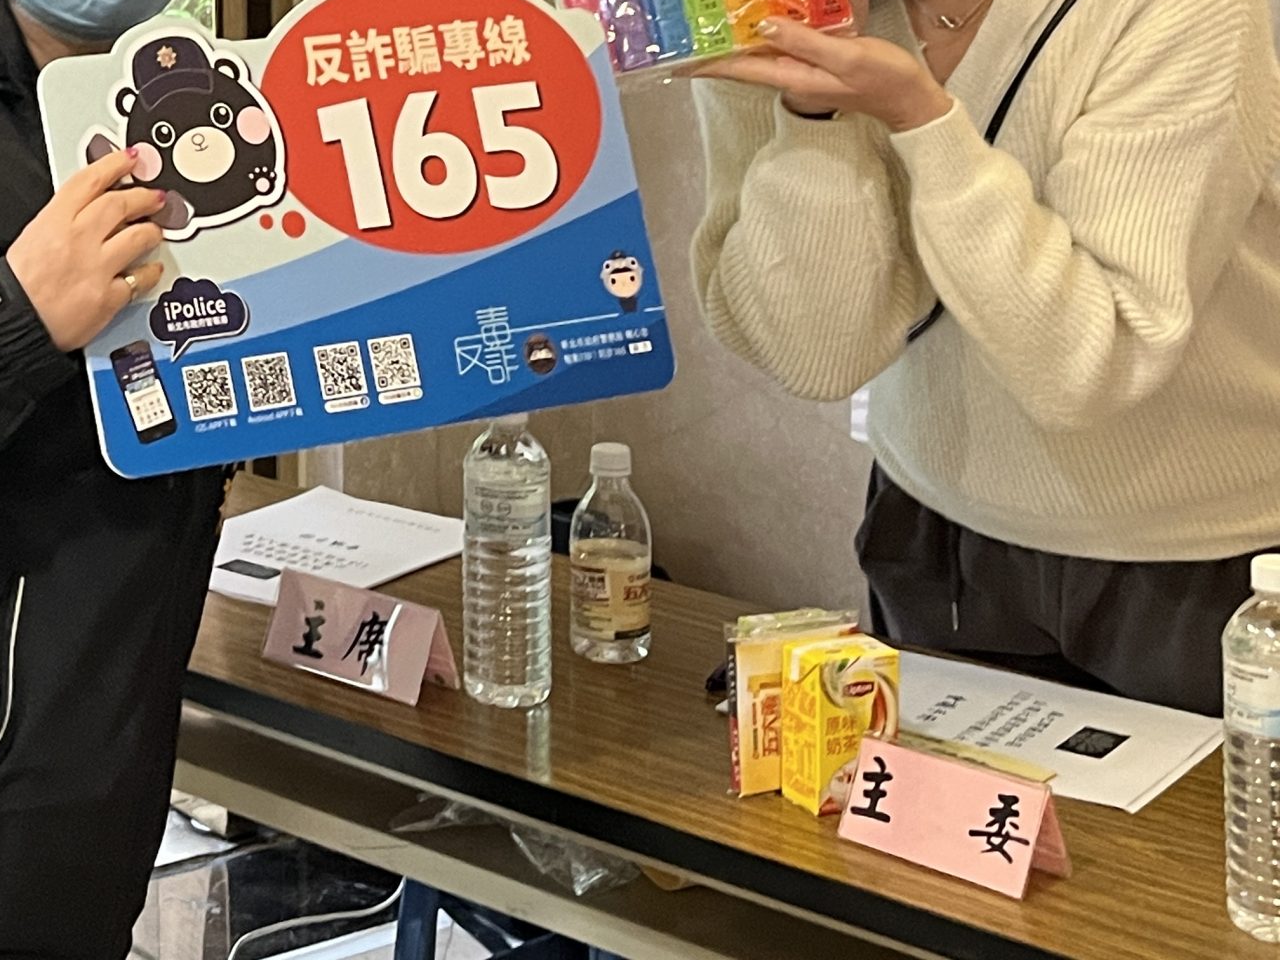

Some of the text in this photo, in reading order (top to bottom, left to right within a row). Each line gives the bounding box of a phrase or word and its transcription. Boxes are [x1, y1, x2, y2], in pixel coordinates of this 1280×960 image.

[303, 15, 532, 86] 反詐騙專線
[317, 81, 559, 231] 165
[163, 297, 227, 321] iPolice
[292, 599, 388, 676] 主席
[850, 756, 1030, 864] 主委
